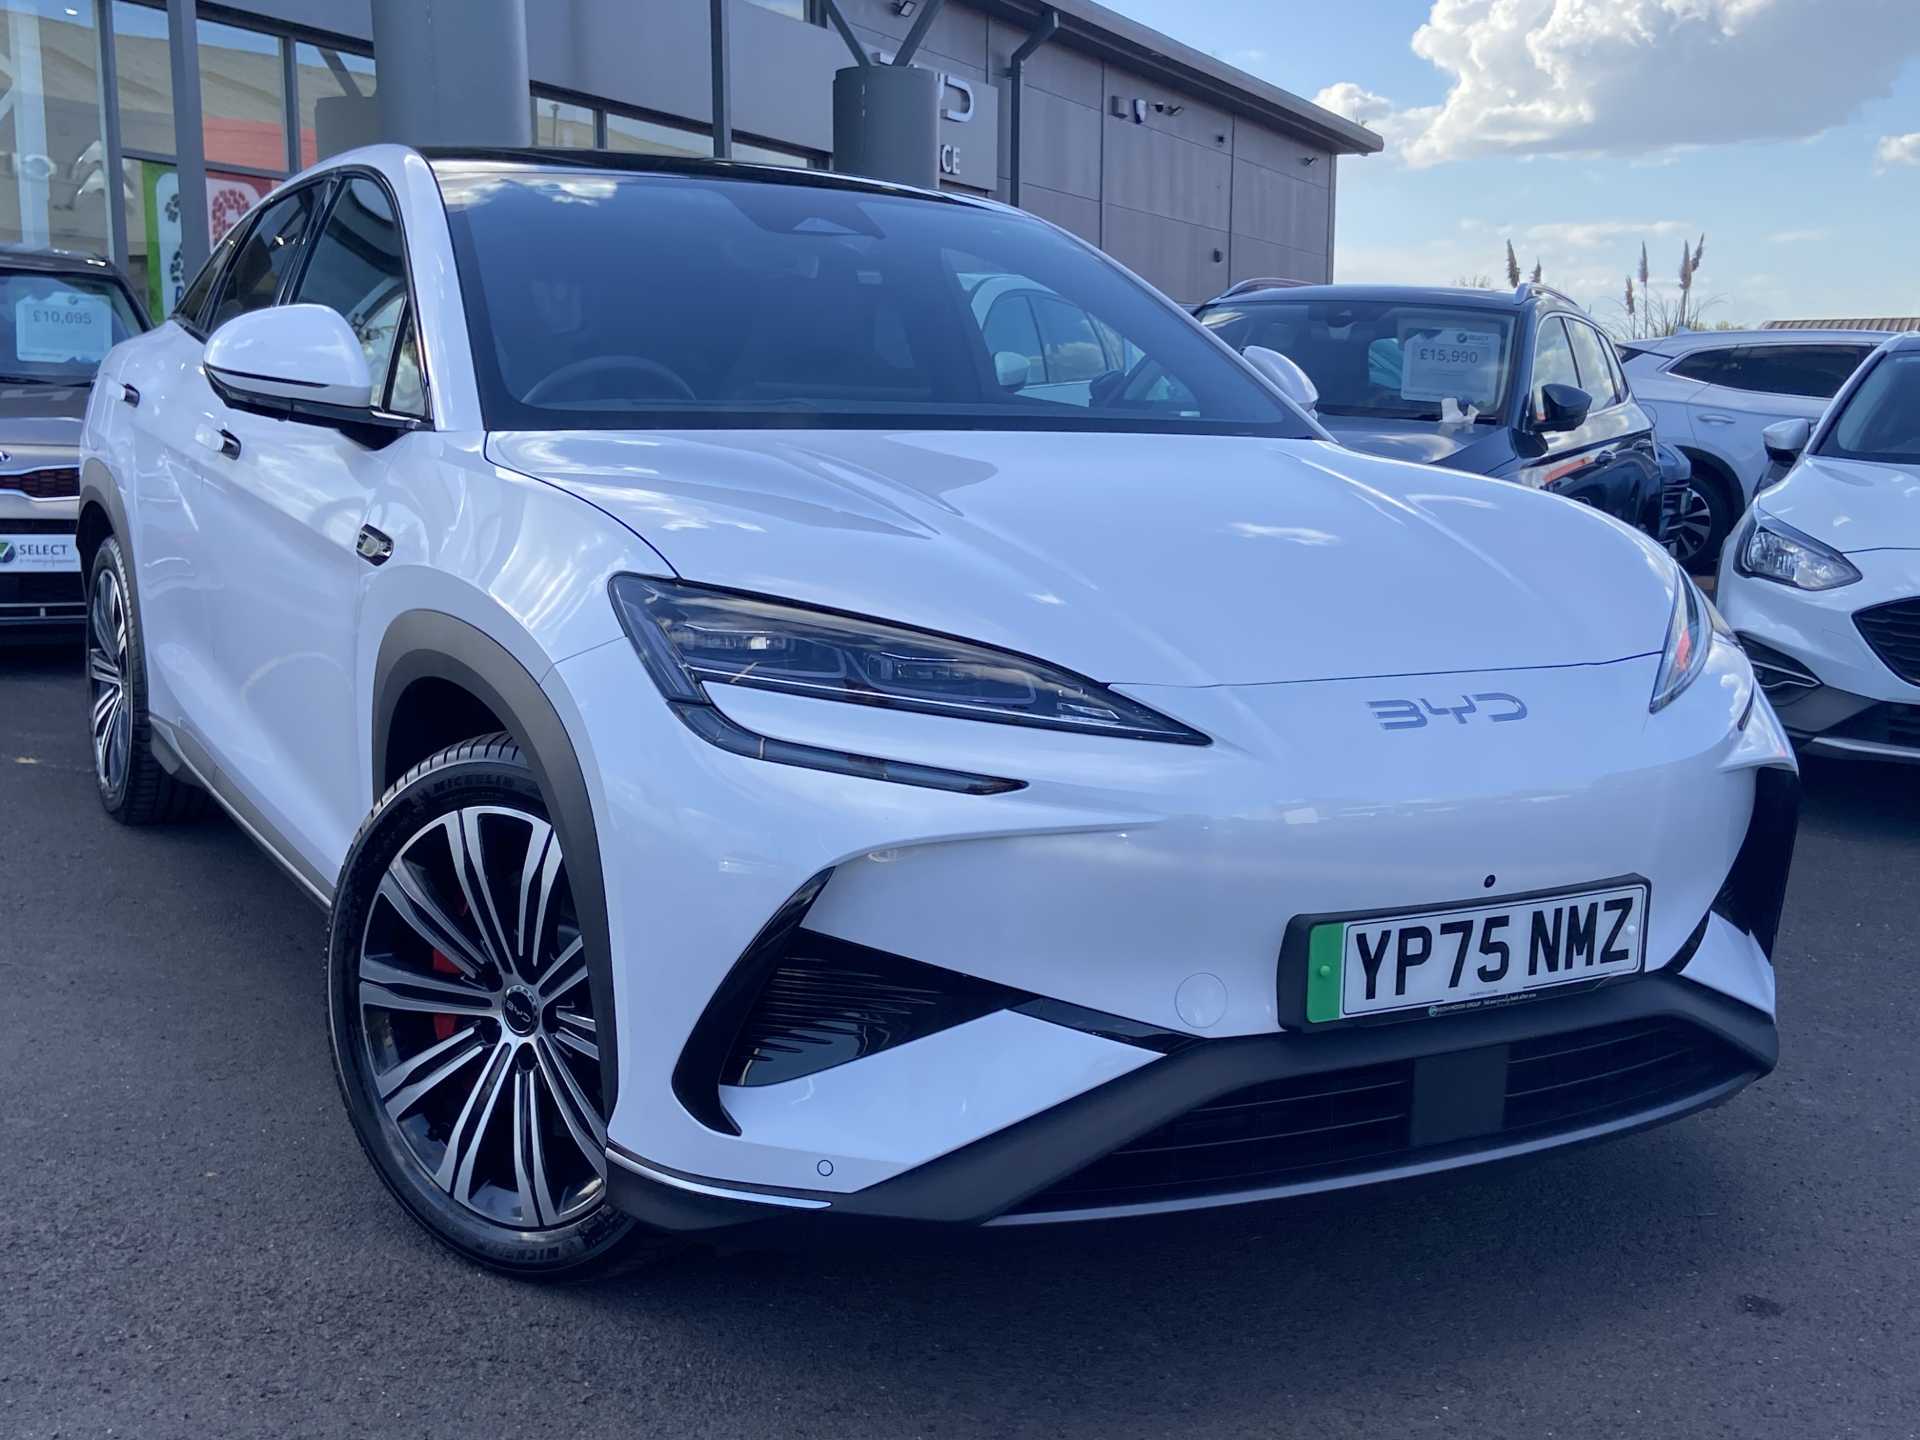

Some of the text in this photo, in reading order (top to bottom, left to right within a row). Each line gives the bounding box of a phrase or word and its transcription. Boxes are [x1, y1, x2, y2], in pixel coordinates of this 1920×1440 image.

[1419, 348, 1479, 364] £15,990
[19, 543, 68, 556] SELECT
[1366, 692, 1528, 731] BYD
[1355, 897, 1634, 1000] YP75 NMZ
